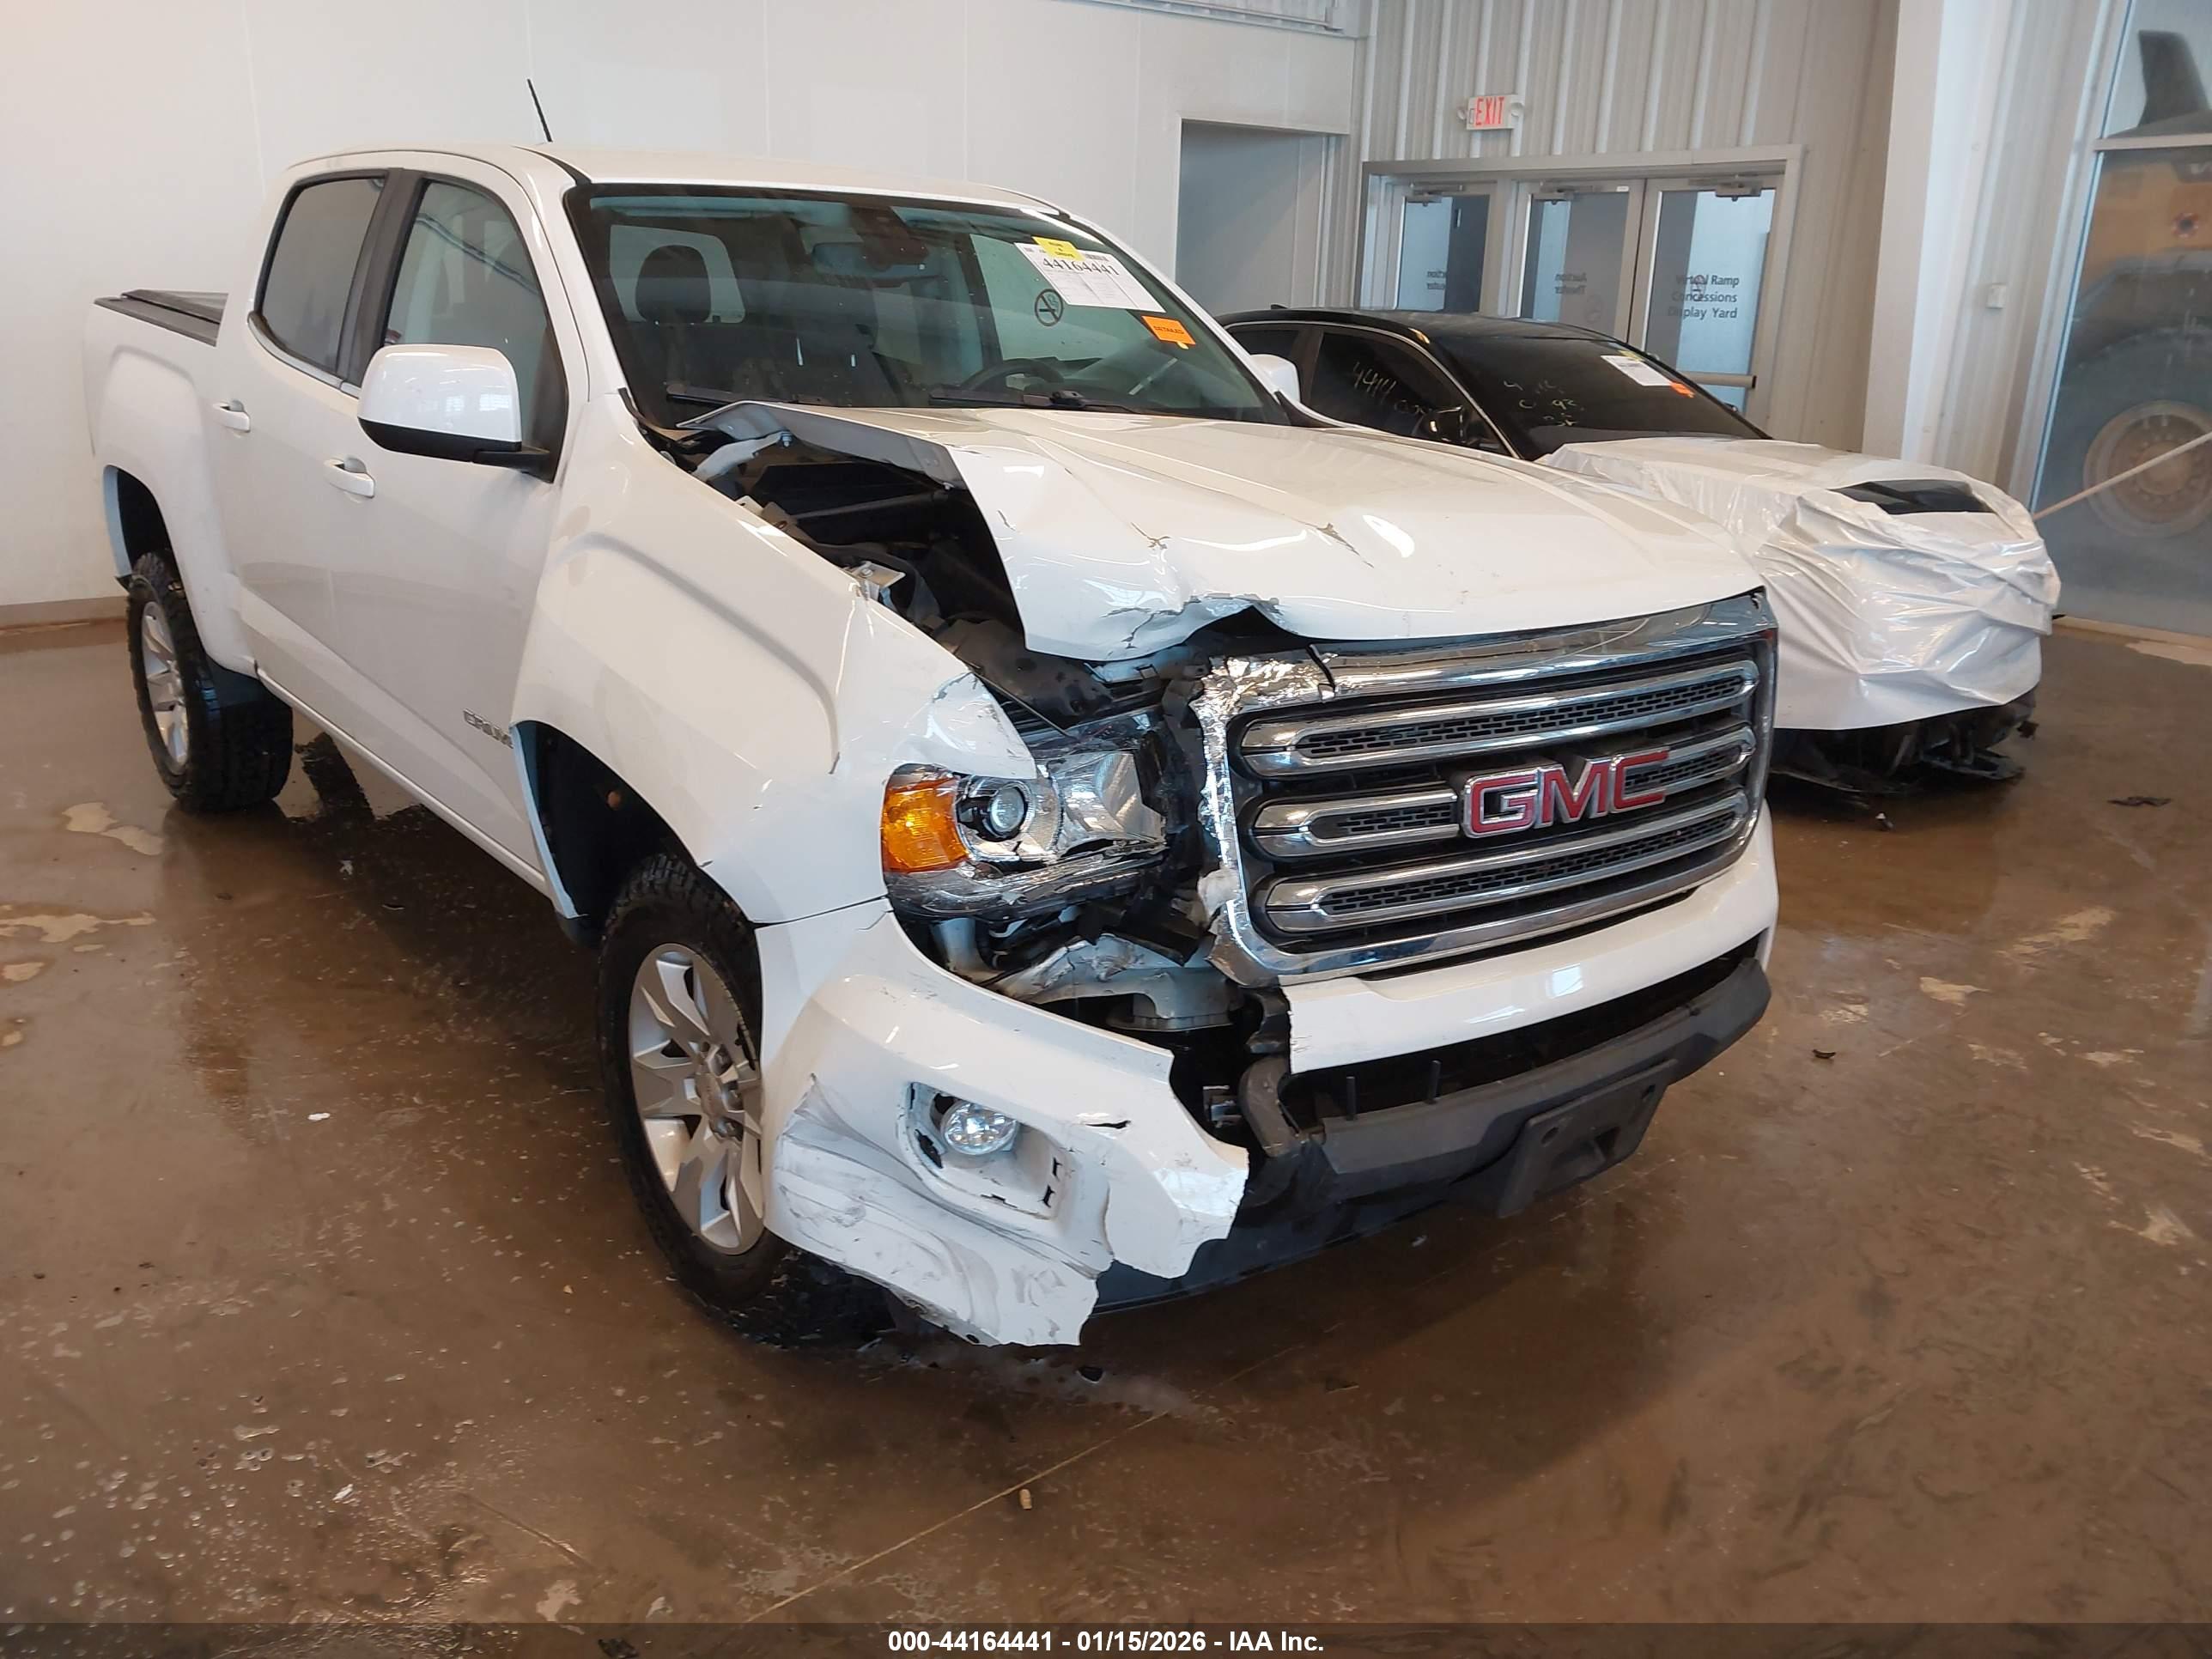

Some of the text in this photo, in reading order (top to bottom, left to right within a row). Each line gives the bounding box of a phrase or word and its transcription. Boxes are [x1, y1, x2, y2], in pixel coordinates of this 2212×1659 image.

[1475, 96, 1505, 125] EXIT
[1042, 258, 1120, 276] 44164441
[1711, 275, 1740, 289] Ramp
[1711, 307, 1738, 319] Yard
[1462, 745, 1670, 839] GMC
